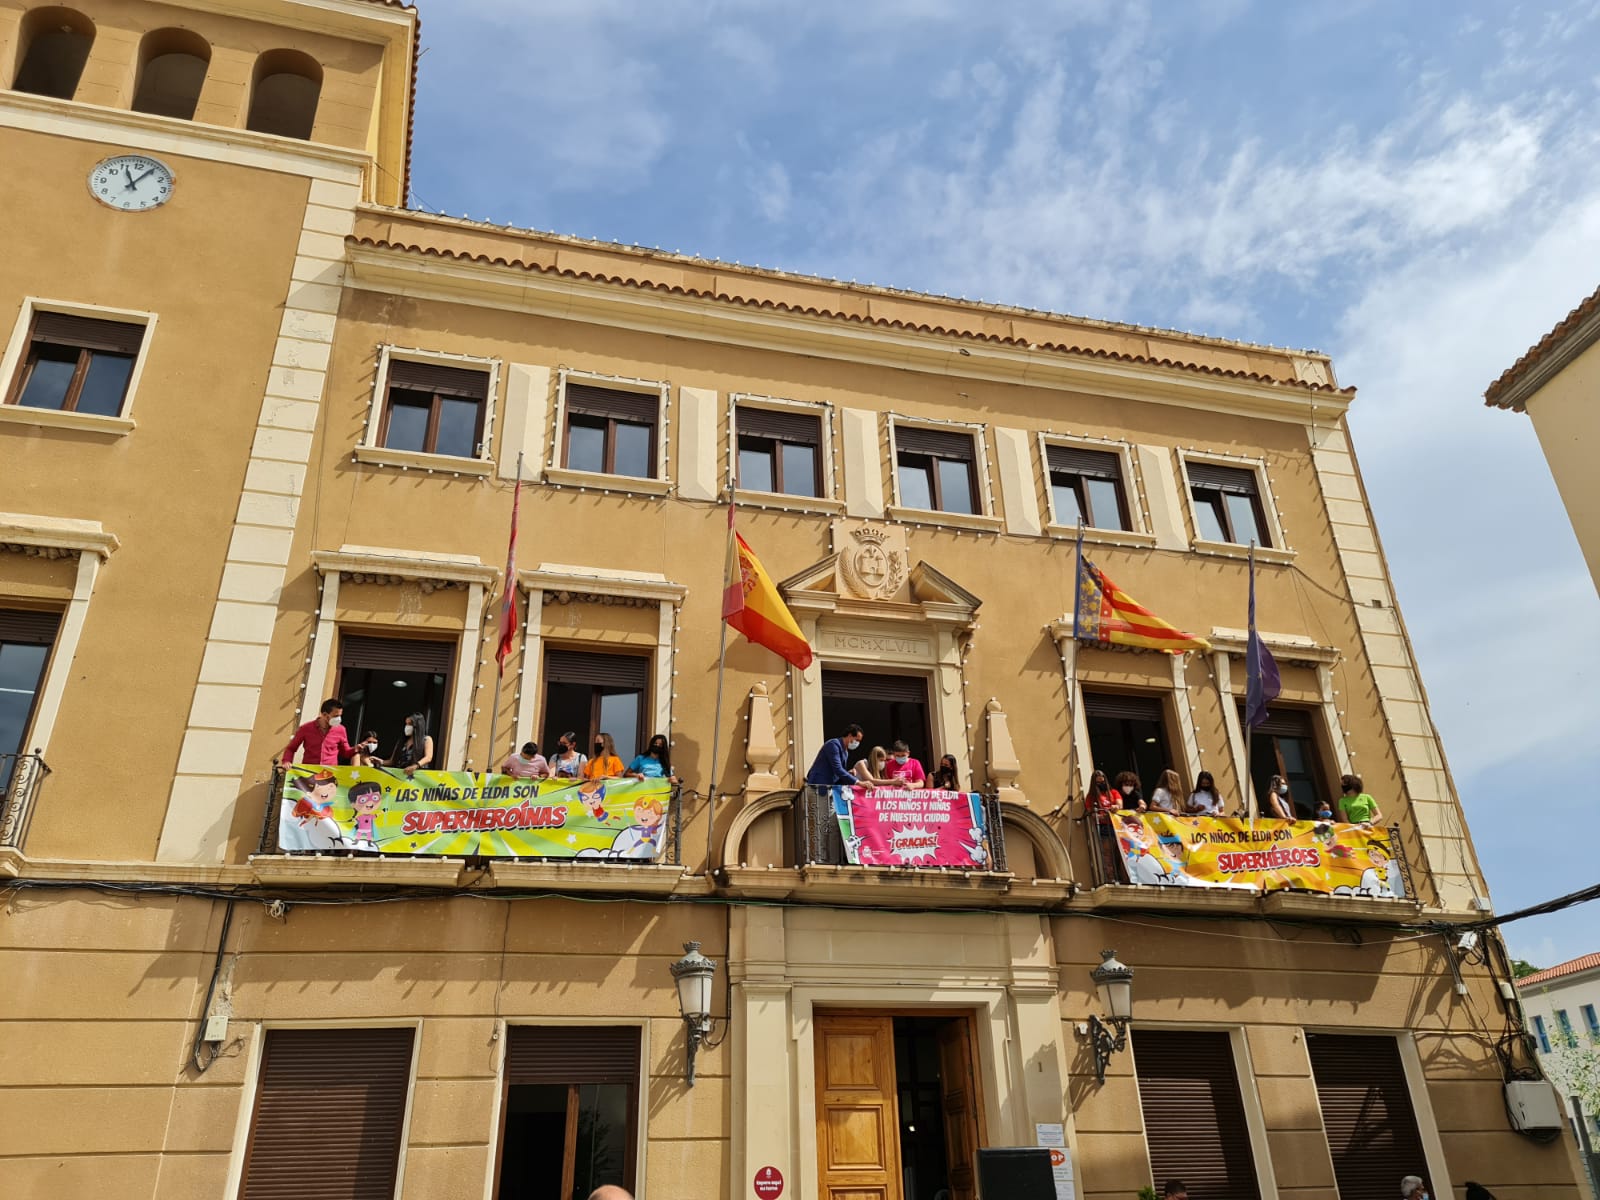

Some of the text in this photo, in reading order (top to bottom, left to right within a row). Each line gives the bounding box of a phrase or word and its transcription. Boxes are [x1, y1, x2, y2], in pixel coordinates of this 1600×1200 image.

[160, 186, 167, 194] 3
[834, 634, 917, 653] MCMXLVII
[396, 784, 540, 802] LAS NIÑAS DE ELDA SON
[864, 789, 959, 800] EL AYUNTAMIENTO DE ELDA
[875, 799, 952, 811] A LOS NIÑOS Y NIÑAS
[401, 800, 568, 834] SUPERHEROÍNAS
[878, 813, 950, 823] DE NUESTRA CIUDAD
[891, 836, 938, 849] ¡GRACIAS!
[1191, 829, 1292, 843] LOS NIÑOS DE ELDA SON
[1217, 844, 1320, 873] SUPERHÉROES
